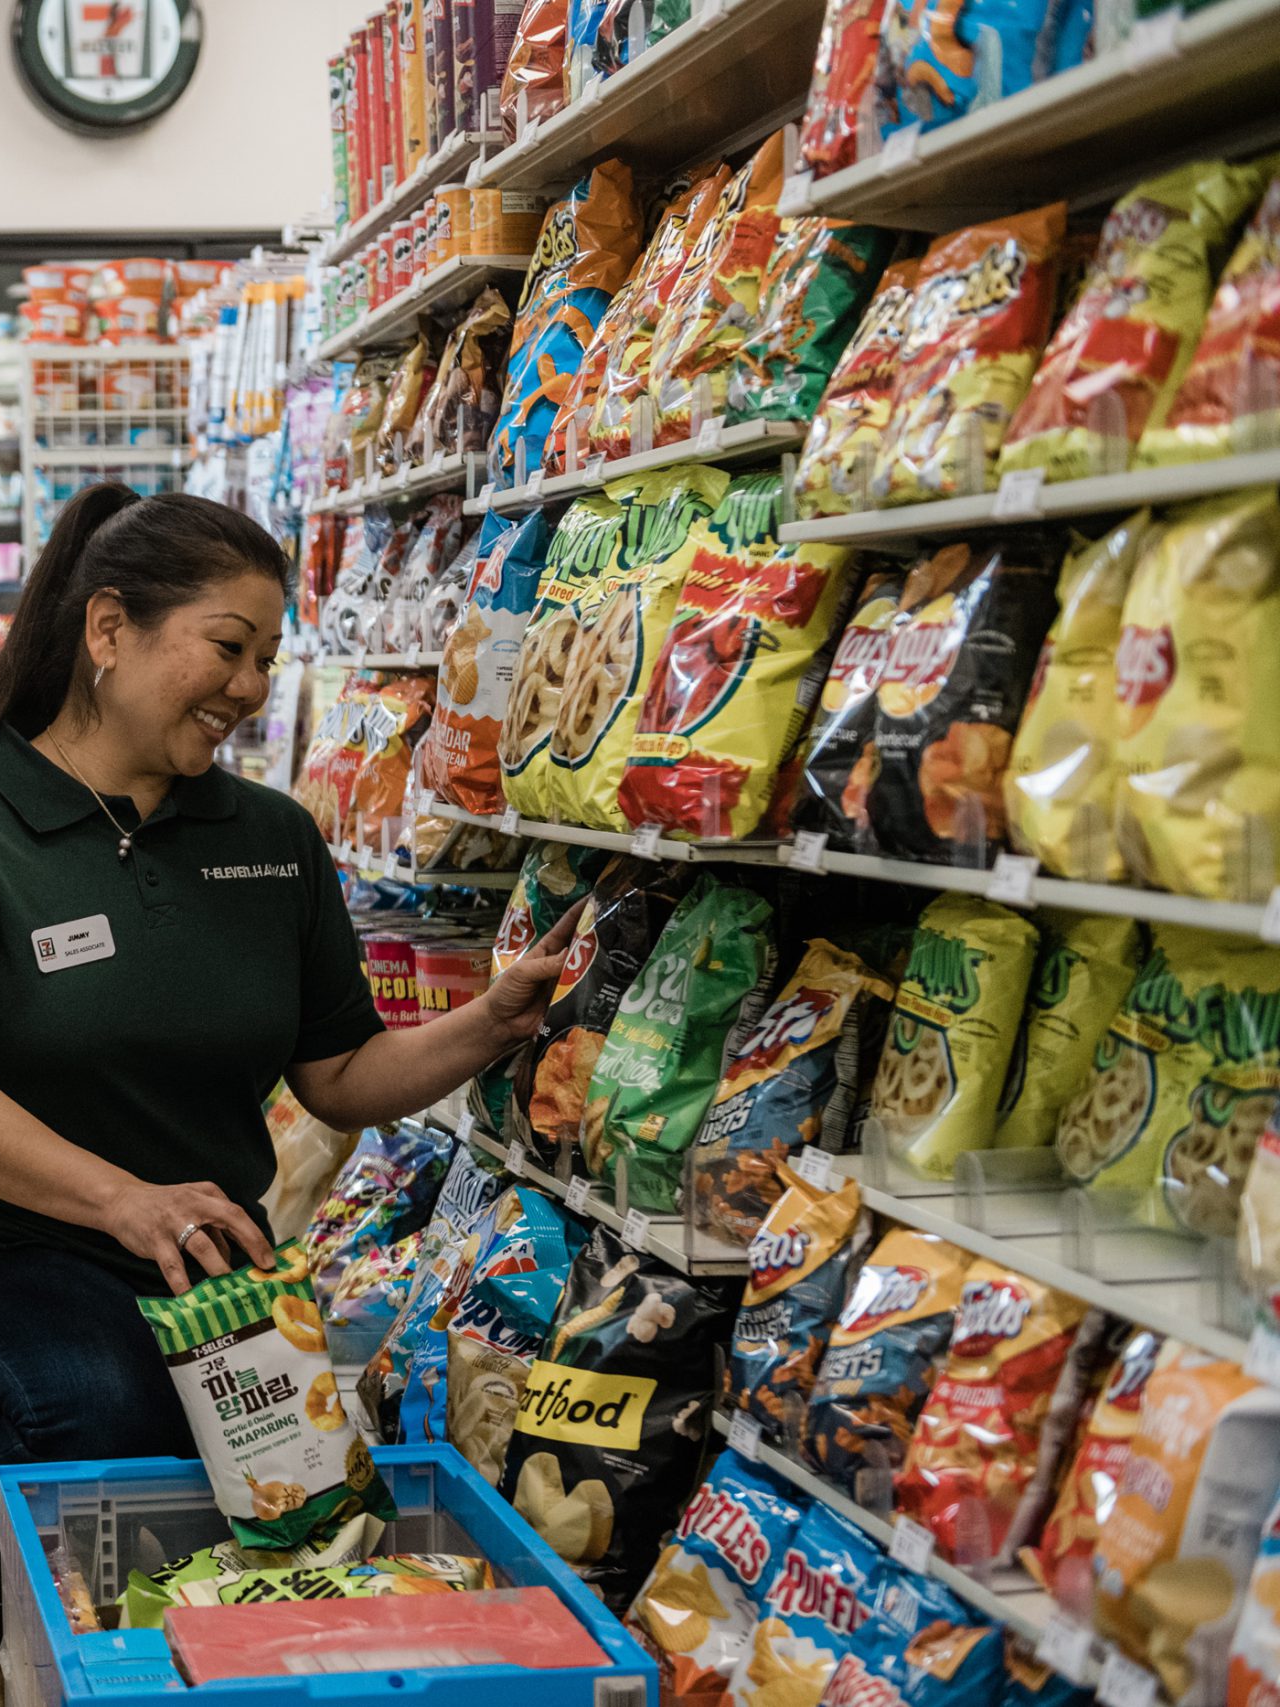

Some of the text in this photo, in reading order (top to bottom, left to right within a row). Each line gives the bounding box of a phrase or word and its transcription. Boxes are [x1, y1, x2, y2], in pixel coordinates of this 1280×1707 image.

[64, 942, 106, 957] SALES ASSOCIATE
[67, 931, 90, 942] JIMMY
[370, 960, 409, 974] CINEMA
[201, 1367, 260, 1401] 마늘
[215, 1373, 299, 1422] 양파링
[223, 1423, 248, 1438] Garlic
[254, 1411, 276, 1425] Onion
[227, 1413, 299, 1449] MAPARING
[677, 1483, 771, 1586] RUFFLES
